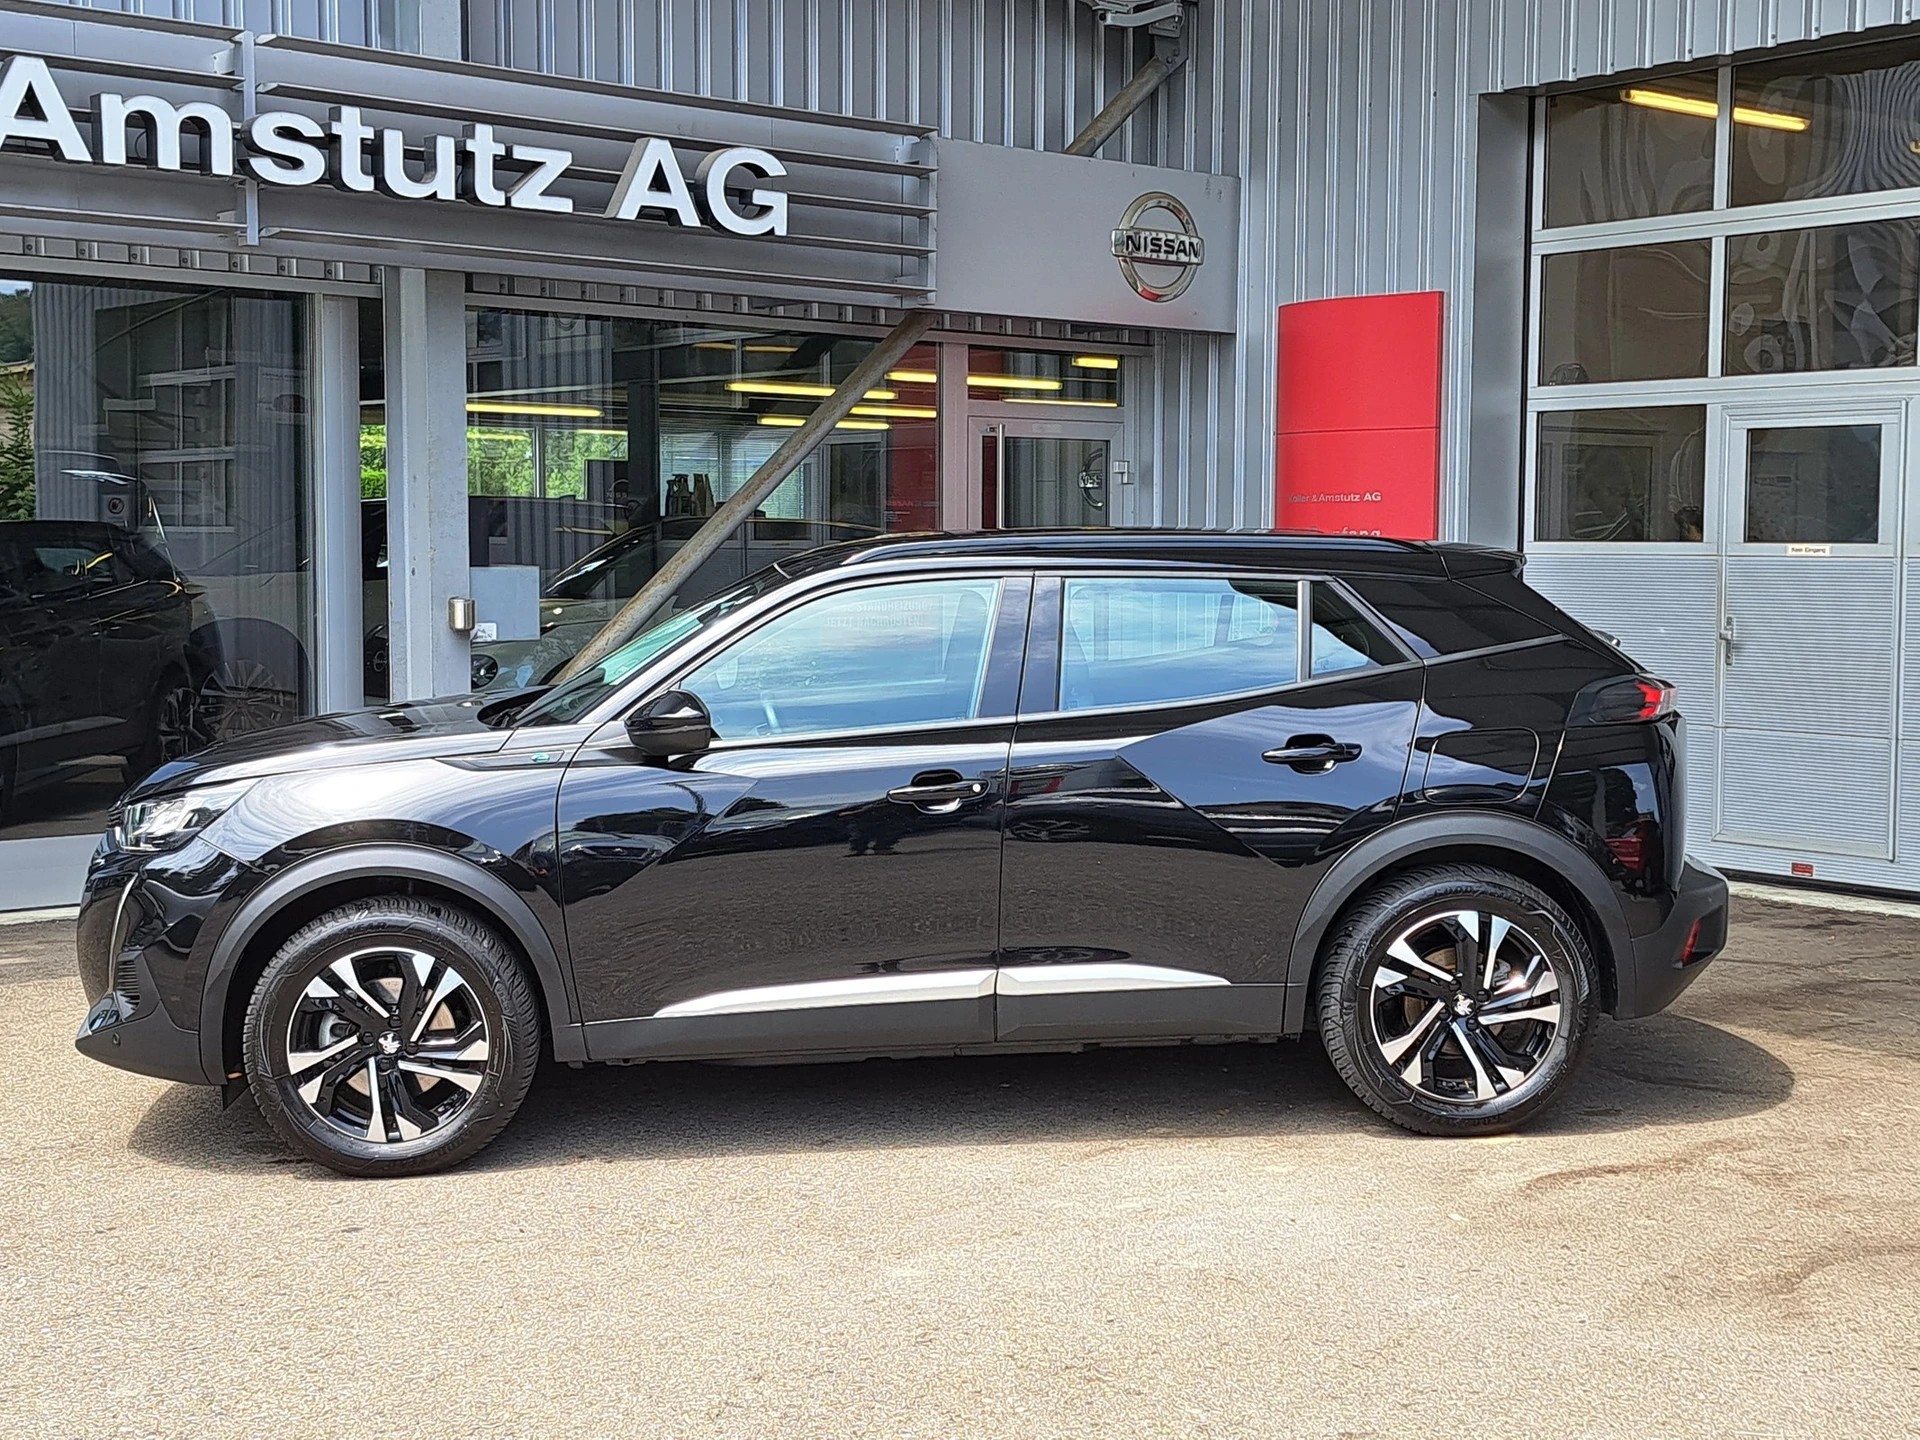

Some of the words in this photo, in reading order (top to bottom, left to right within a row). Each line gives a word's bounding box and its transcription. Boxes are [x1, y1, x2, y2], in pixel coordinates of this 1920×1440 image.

[0, 55, 573, 213] Amstutz
[611, 137, 788, 237] AG
[1125, 234, 1200, 258] NISSAN
[1319, 492, 1361, 502] Amstutz
[1363, 491, 1382, 501] AG
